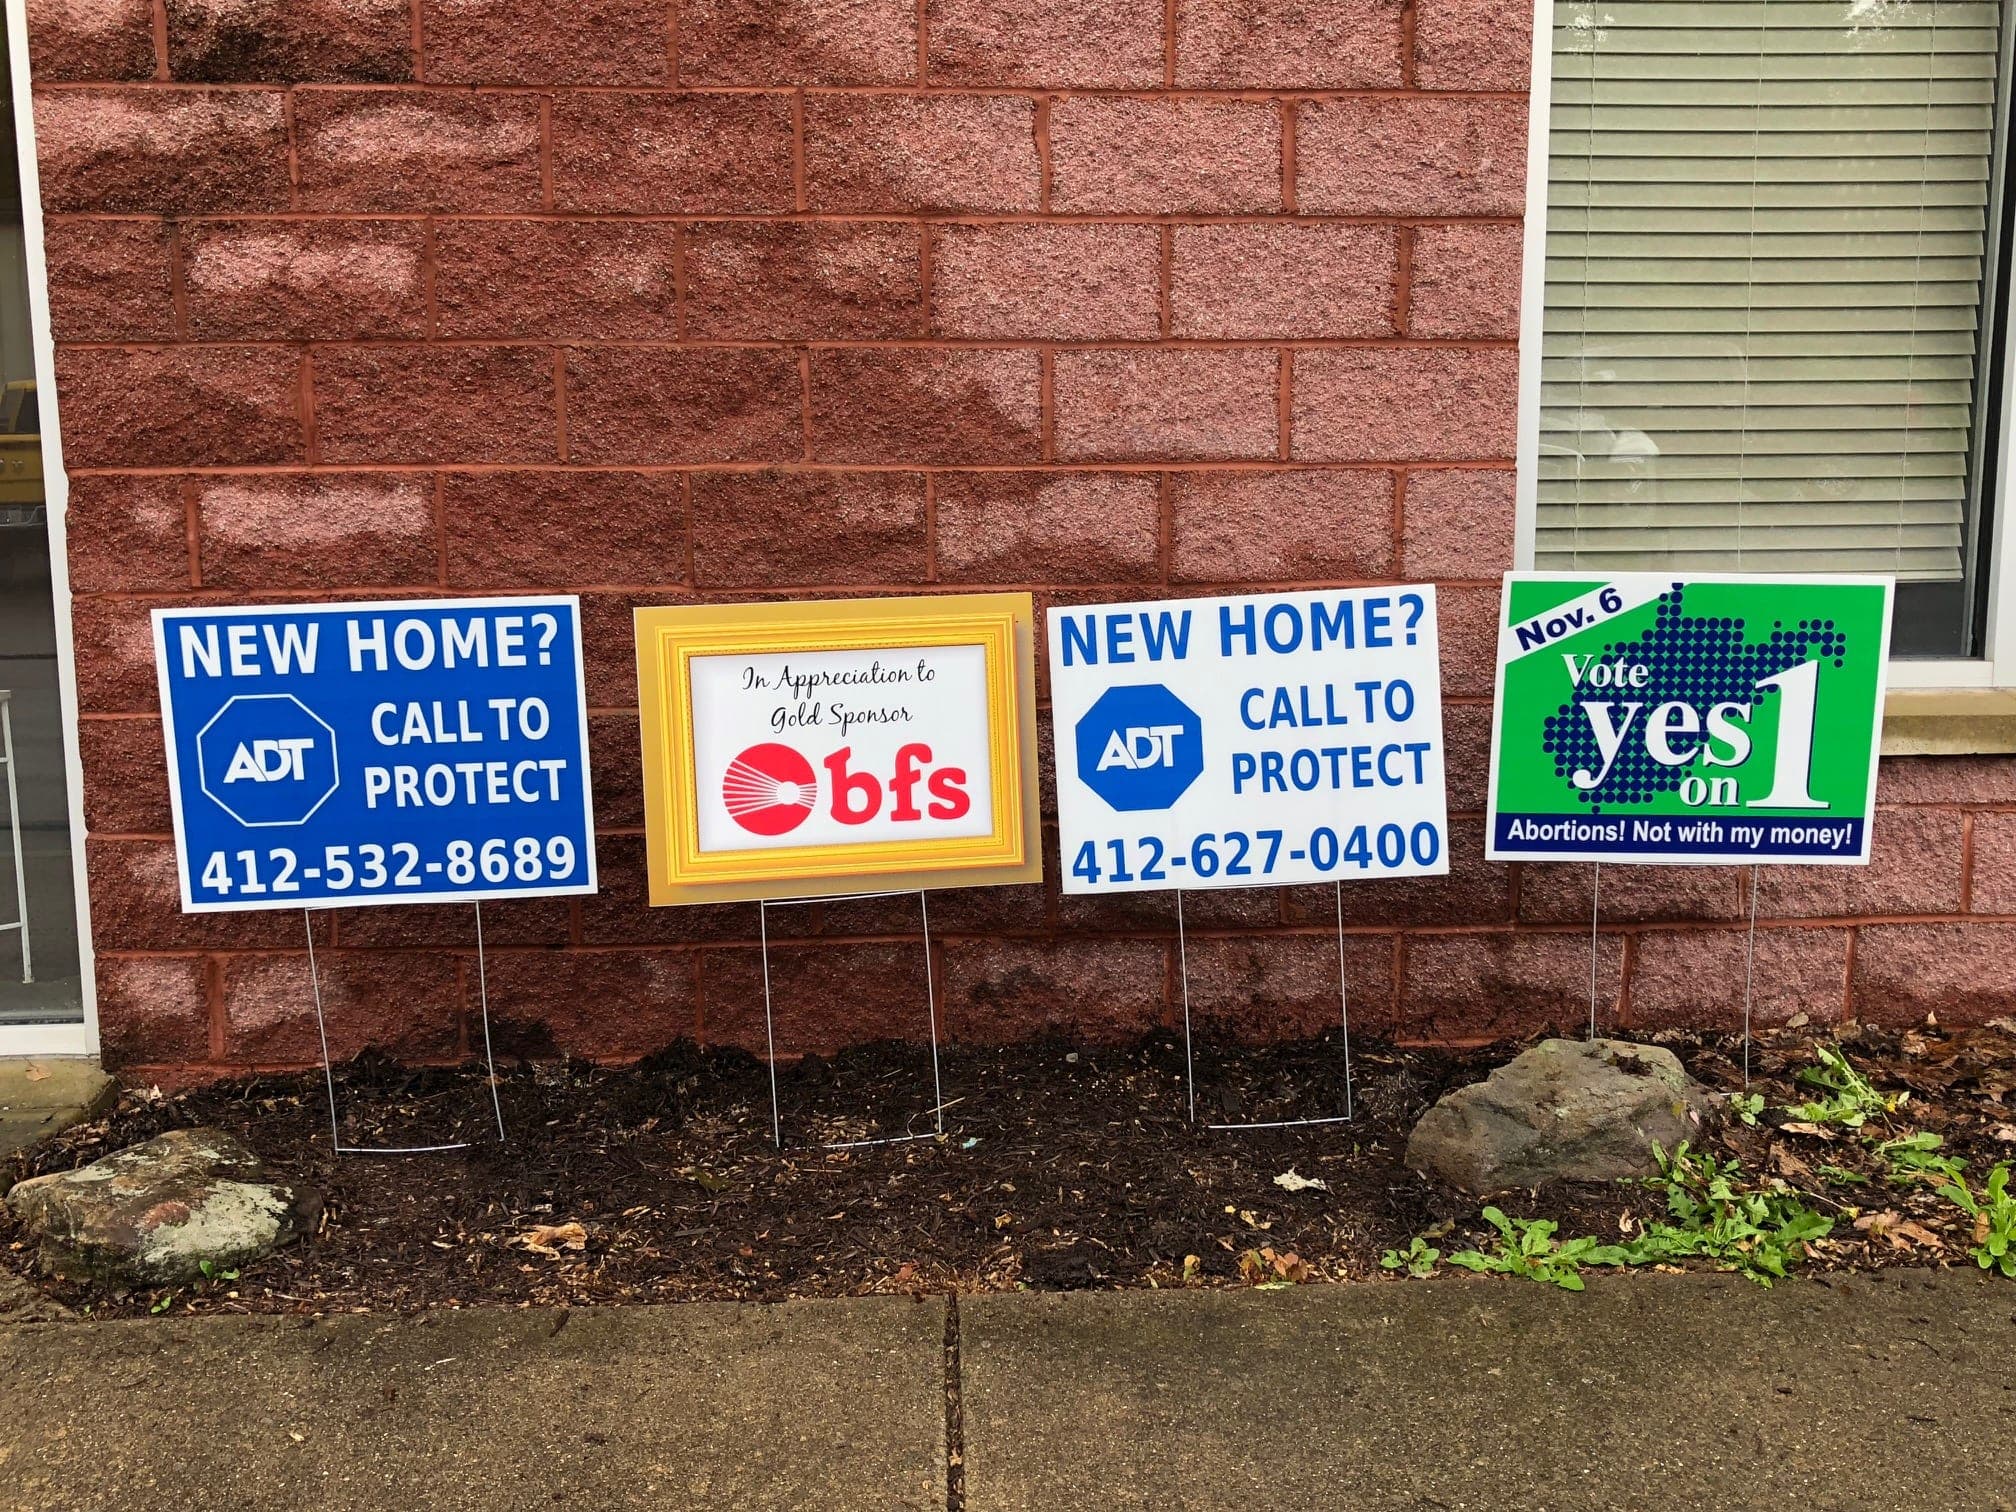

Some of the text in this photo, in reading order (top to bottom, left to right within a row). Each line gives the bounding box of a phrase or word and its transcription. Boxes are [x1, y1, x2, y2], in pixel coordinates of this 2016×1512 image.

[1060, 594, 1424, 666] NEW HOME?
[1515, 588, 1623, 651] Nov. 6
[179, 614, 557, 678] NEW HOME?
[1561, 653, 1650, 688] Vote
[743, 659, 935, 699] In Appreciation to
[1240, 679, 1414, 730] CALL TO
[371, 697, 549, 745] CALL TO
[770, 703, 913, 737] Gold Sponsor
[1572, 699, 1752, 790] yes
[1680, 660, 1830, 809] on 1
[223, 738, 314, 783] ADT
[1096, 725, 1183, 771] ADT
[1232, 742, 1431, 794] PROTECT
[364, 759, 566, 808] PROTECT
[823, 743, 970, 825] bfs
[1072, 821, 1439, 884] 412-627-0400
[1508, 819, 1852, 849] Abortions! Not with my money!
[202, 836, 575, 894] 412-532-8689
